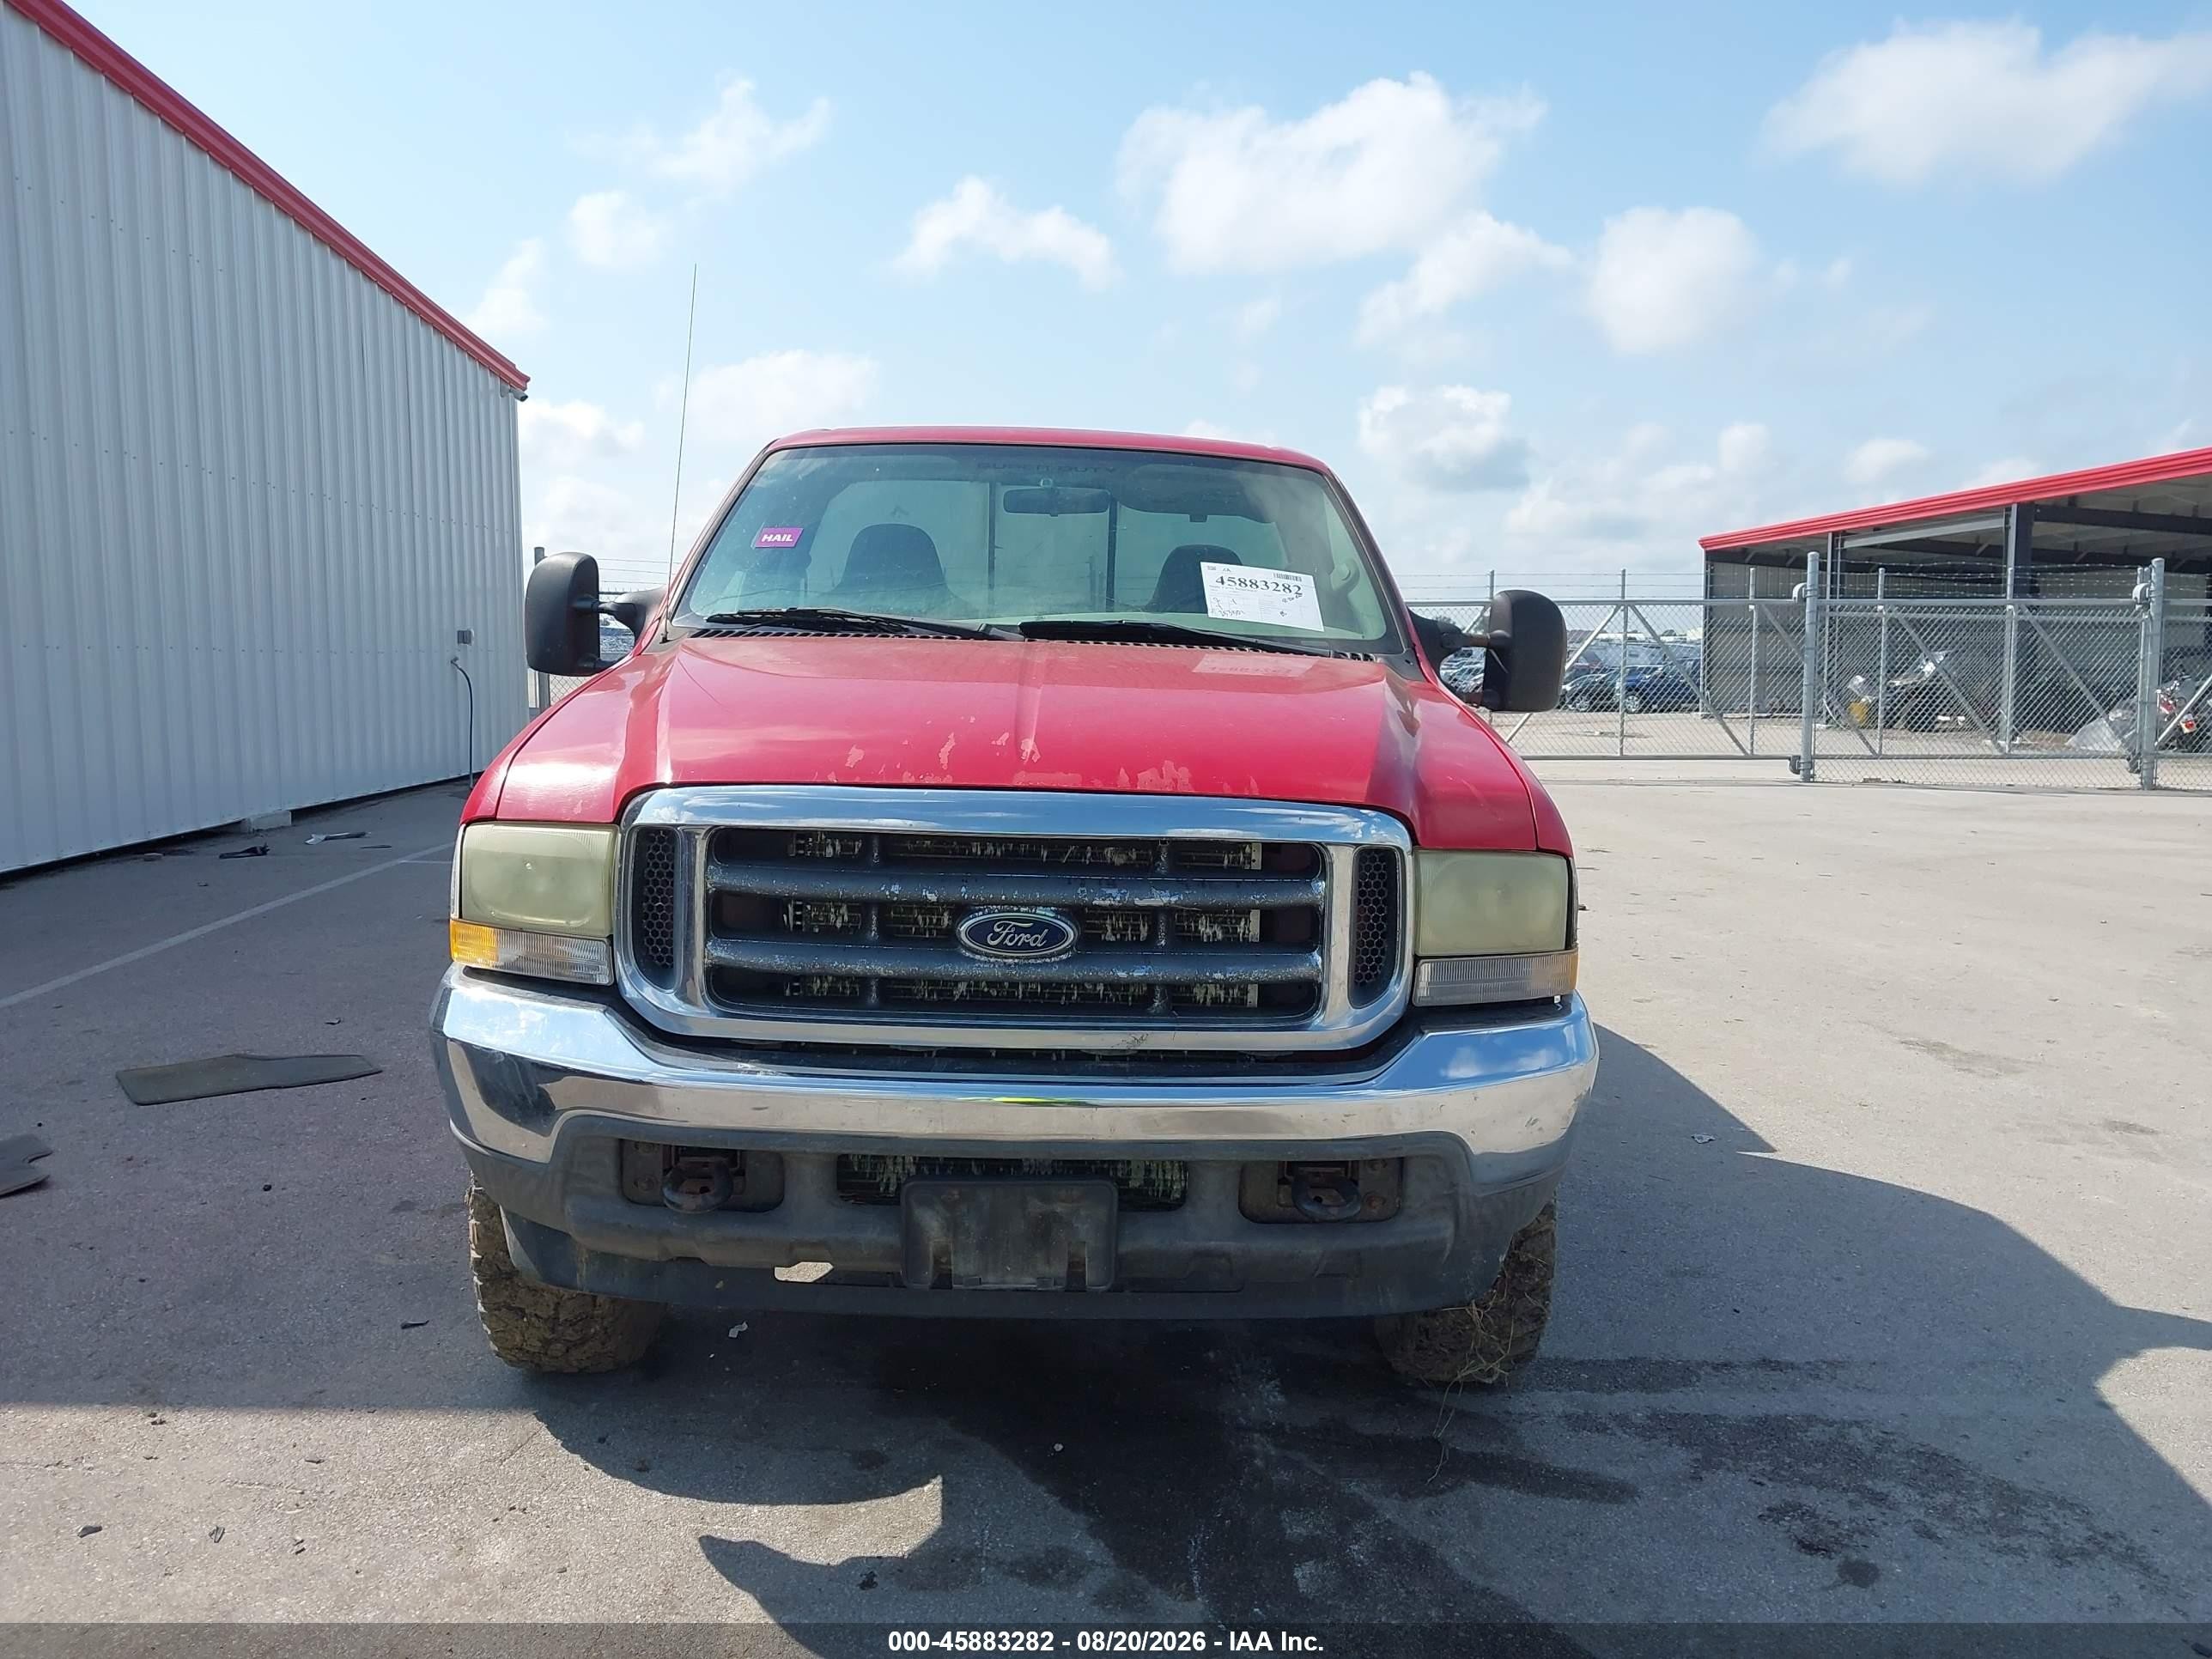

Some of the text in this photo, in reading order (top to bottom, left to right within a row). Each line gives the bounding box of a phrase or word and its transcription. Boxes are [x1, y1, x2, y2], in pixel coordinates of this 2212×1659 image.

[761, 533, 793, 543] HAIL
[1215, 575, 1303, 595] 45883282
[988, 921, 1050, 947] Ford
